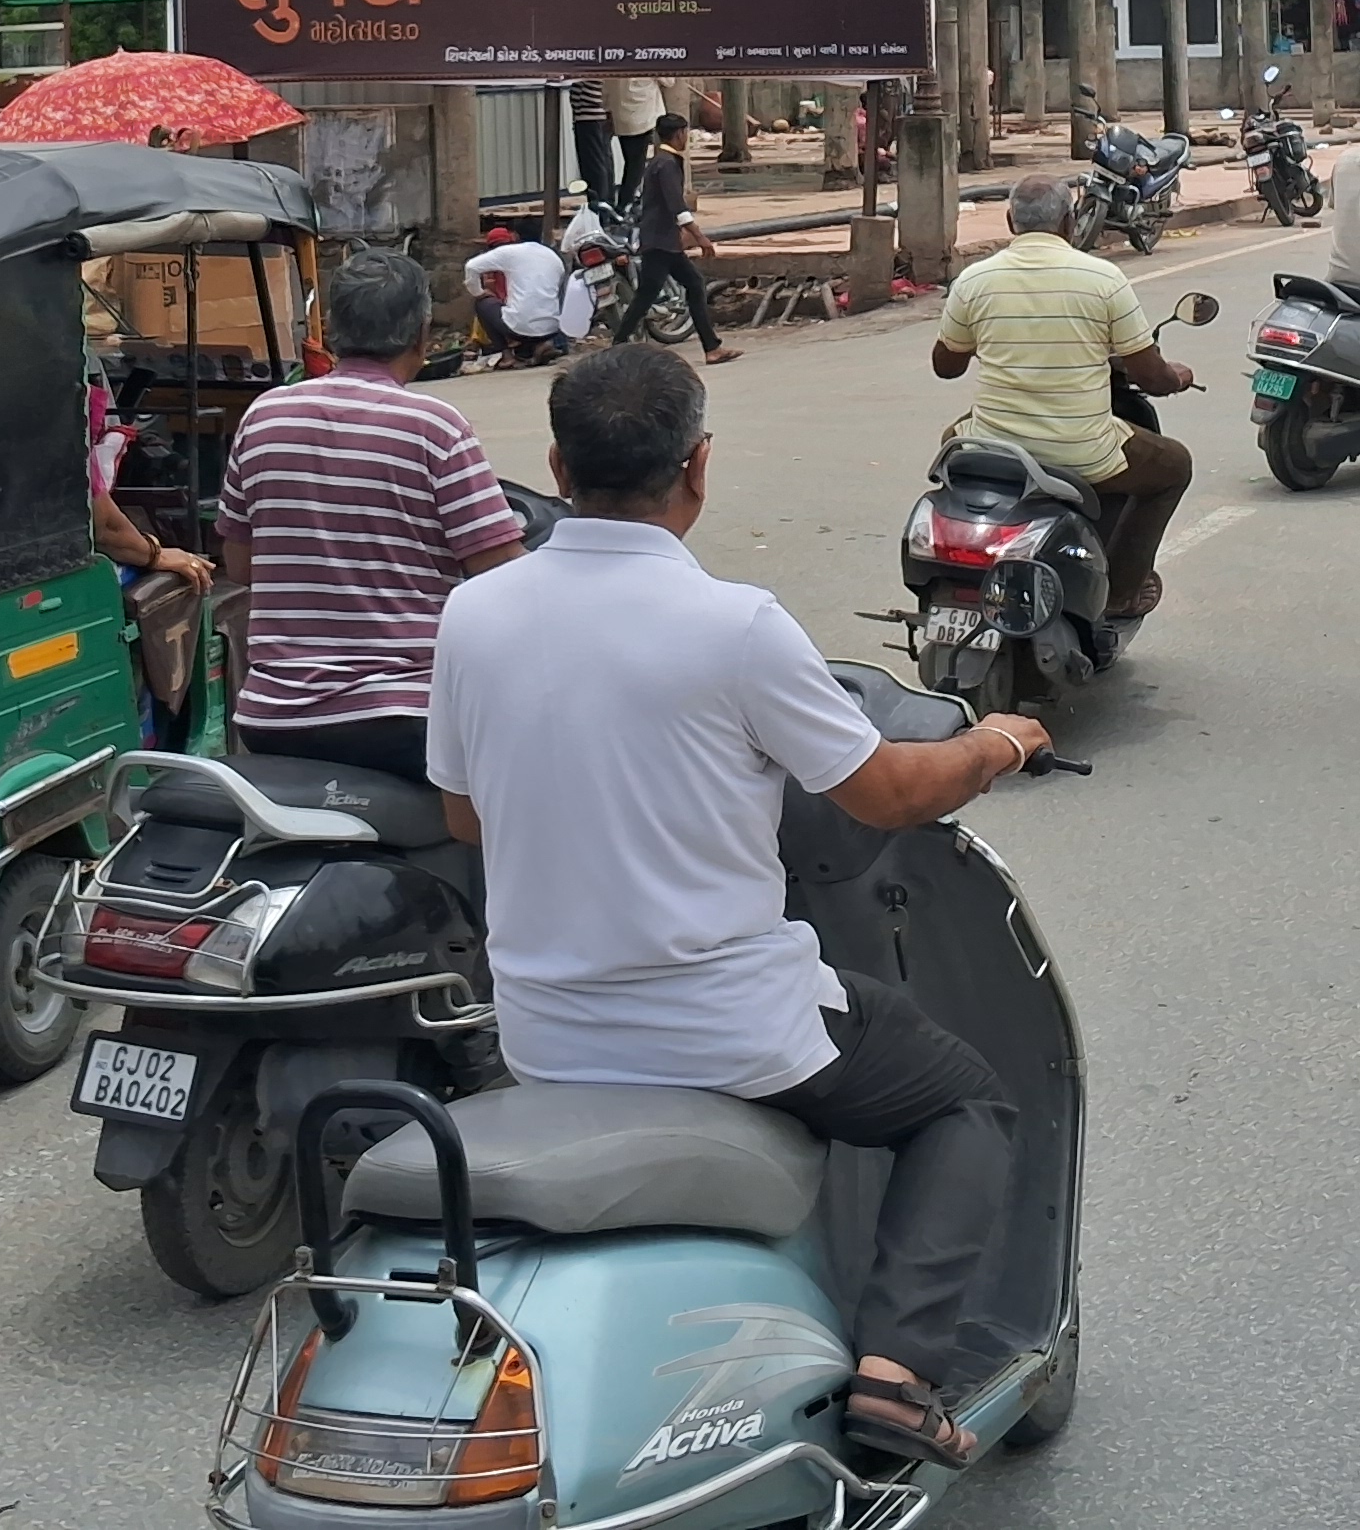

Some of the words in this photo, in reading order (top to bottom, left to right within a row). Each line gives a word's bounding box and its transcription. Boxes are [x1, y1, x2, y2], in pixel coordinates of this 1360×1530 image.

[310, 13, 387, 44] મહોત્સવ
[544, 49, 597, 62] અમદાવાદ
[604, 48, 624, 60] 079
[635, 47, 687, 60] 26779900
[949, 610, 979, 627] GJ0
[112, 1046, 175, 1082] GJ02
[95, 1075, 186, 1116] BA0402
[680, 1399, 745, 1424] Honda
[623, 1413, 763, 1472] Activa
